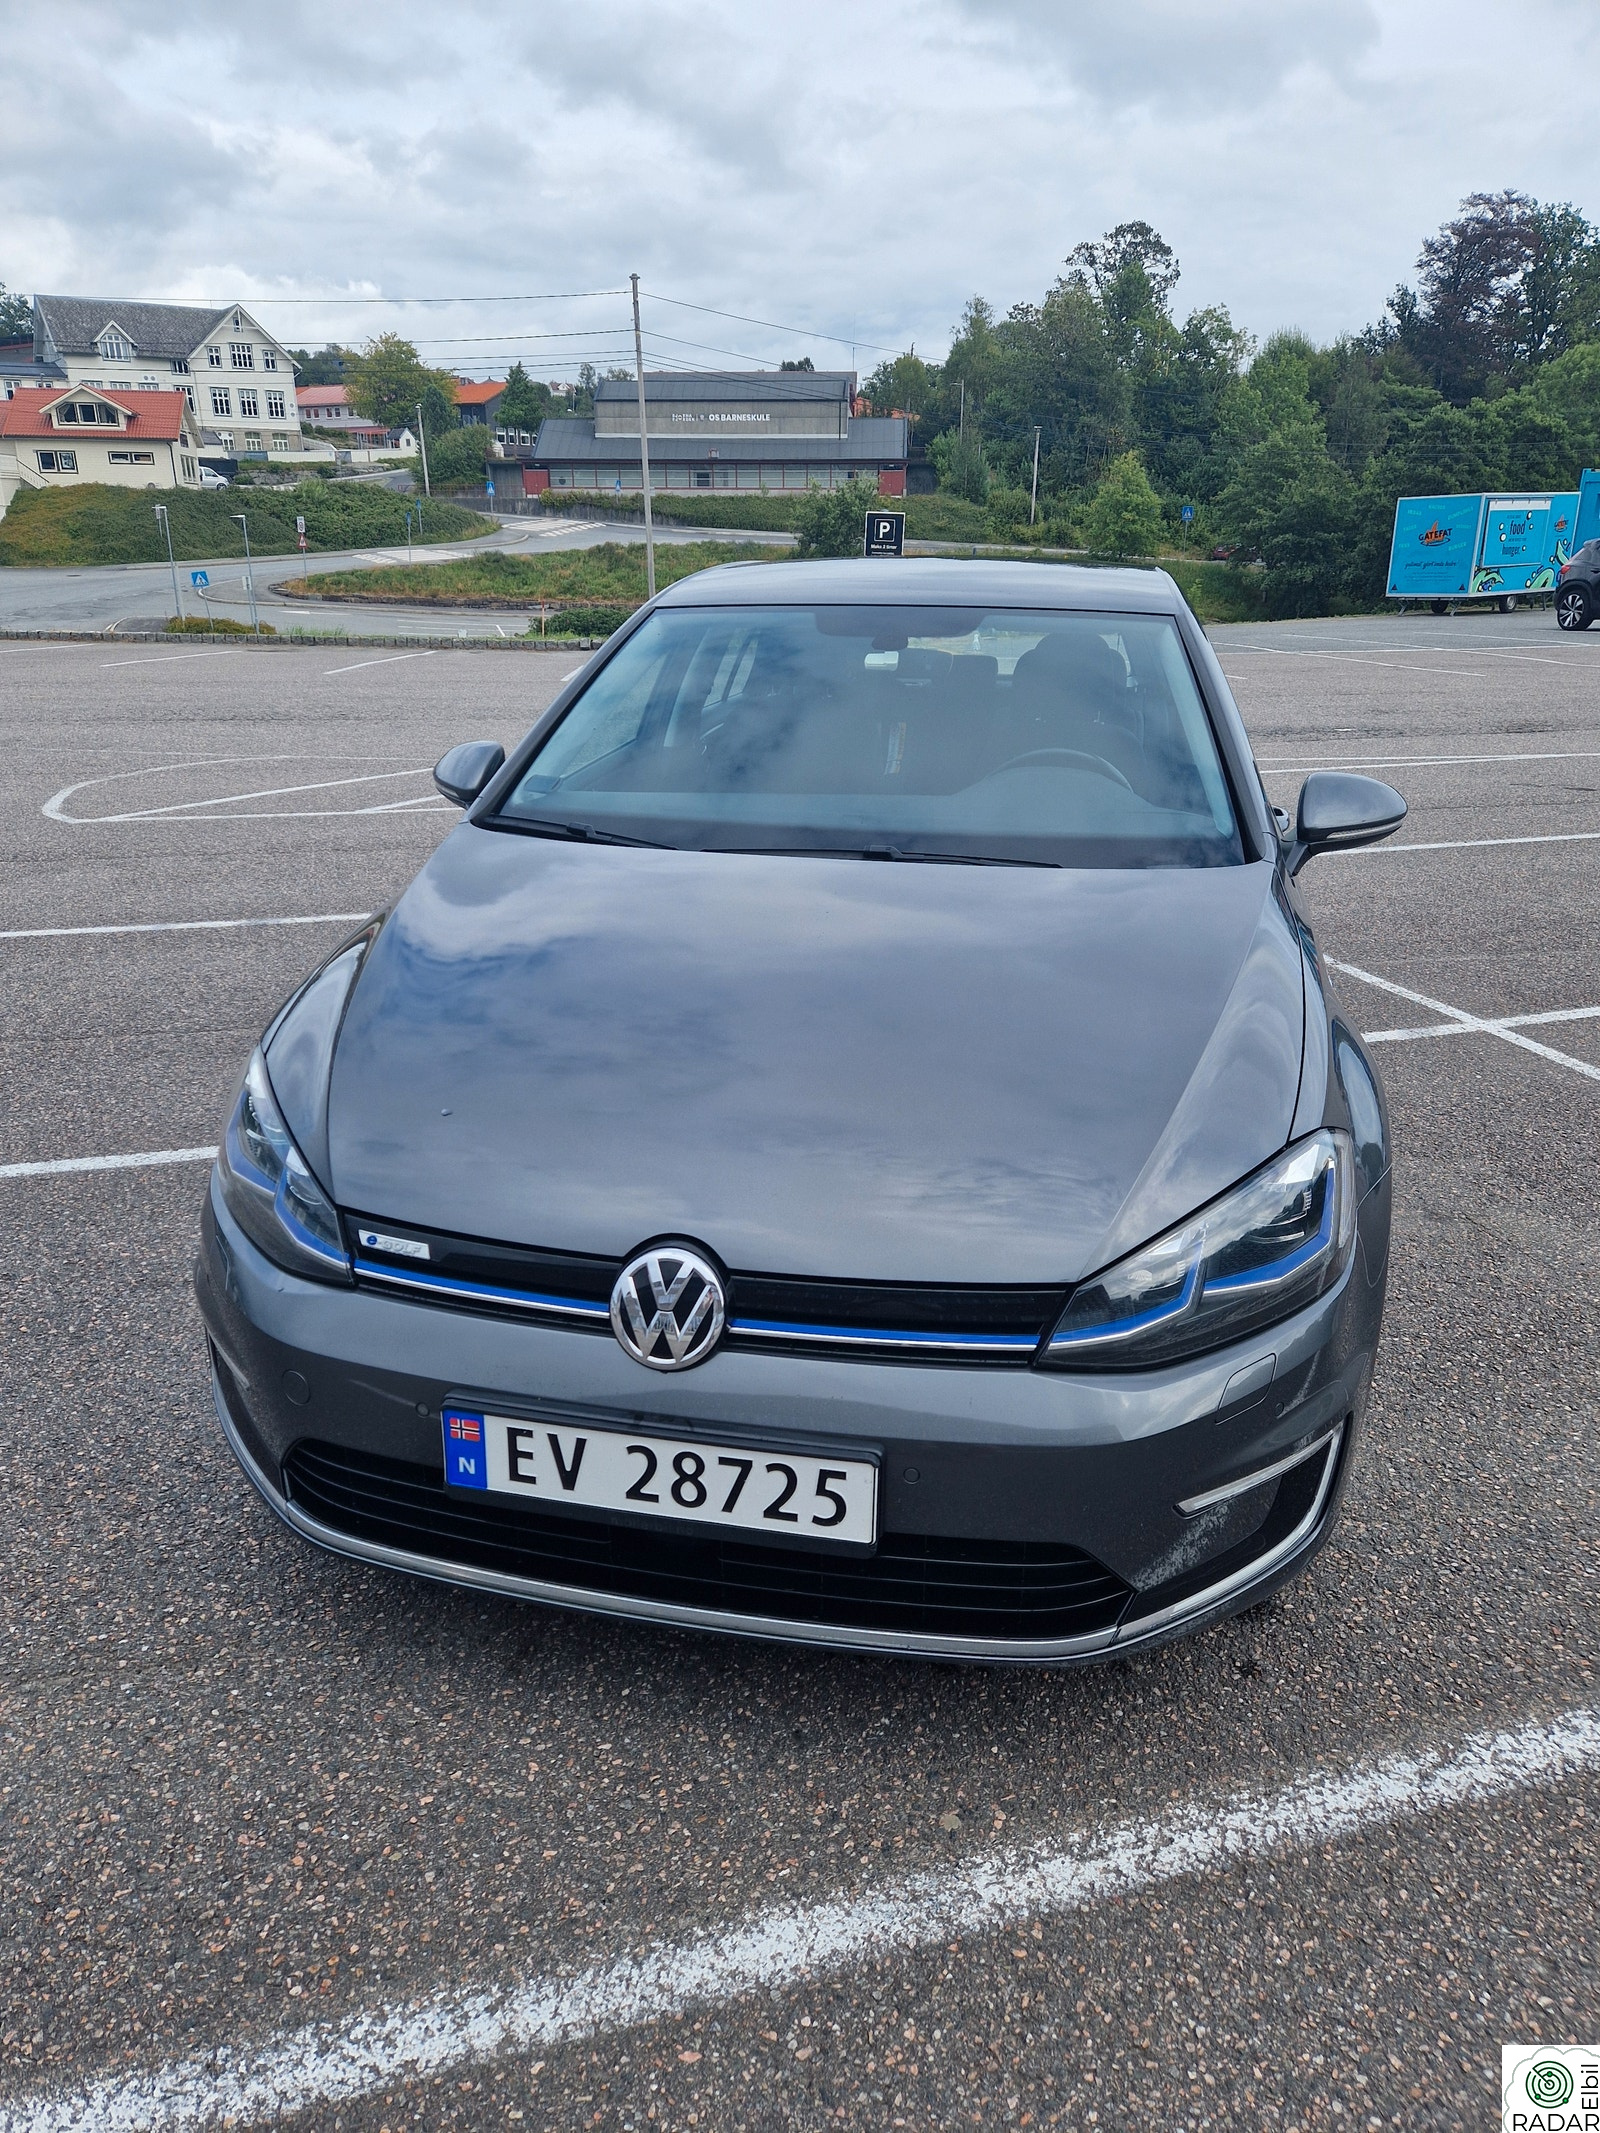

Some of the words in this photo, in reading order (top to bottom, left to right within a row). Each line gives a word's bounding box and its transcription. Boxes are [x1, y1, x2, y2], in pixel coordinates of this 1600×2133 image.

[708, 413, 720, 422] OS
[720, 413, 771, 422] BARNESKULE
[879, 521, 891, 539] P
[1418, 528, 1453, 541] GATEFAT
[1509, 519, 1527, 535] food
[458, 1456, 476, 1475] N
[506, 1426, 588, 1491] EV
[624, 1444, 849, 1527] 28725
